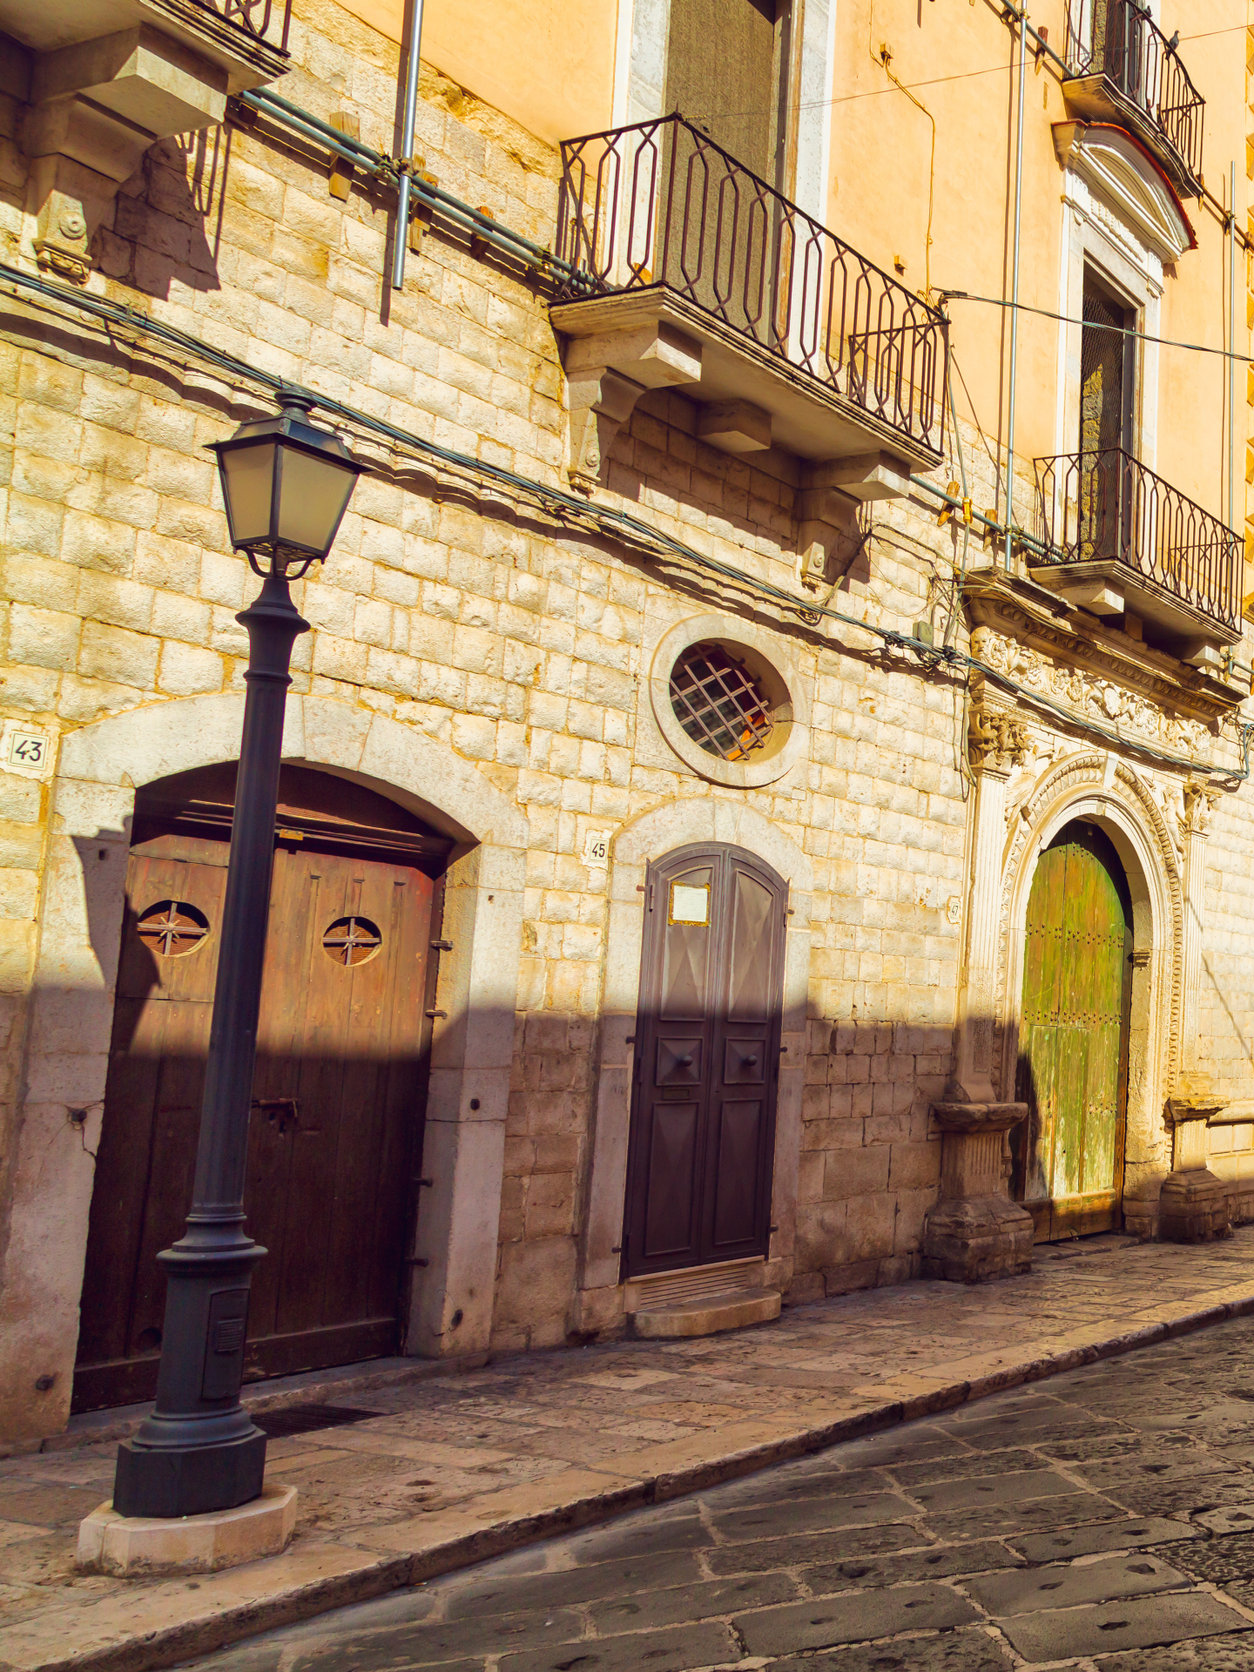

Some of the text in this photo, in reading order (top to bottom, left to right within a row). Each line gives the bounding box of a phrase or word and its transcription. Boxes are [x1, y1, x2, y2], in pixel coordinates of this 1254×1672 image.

[15, 740, 42, 762] 43
[592, 843, 605, 858] 45
[951, 904, 959, 916] 47
